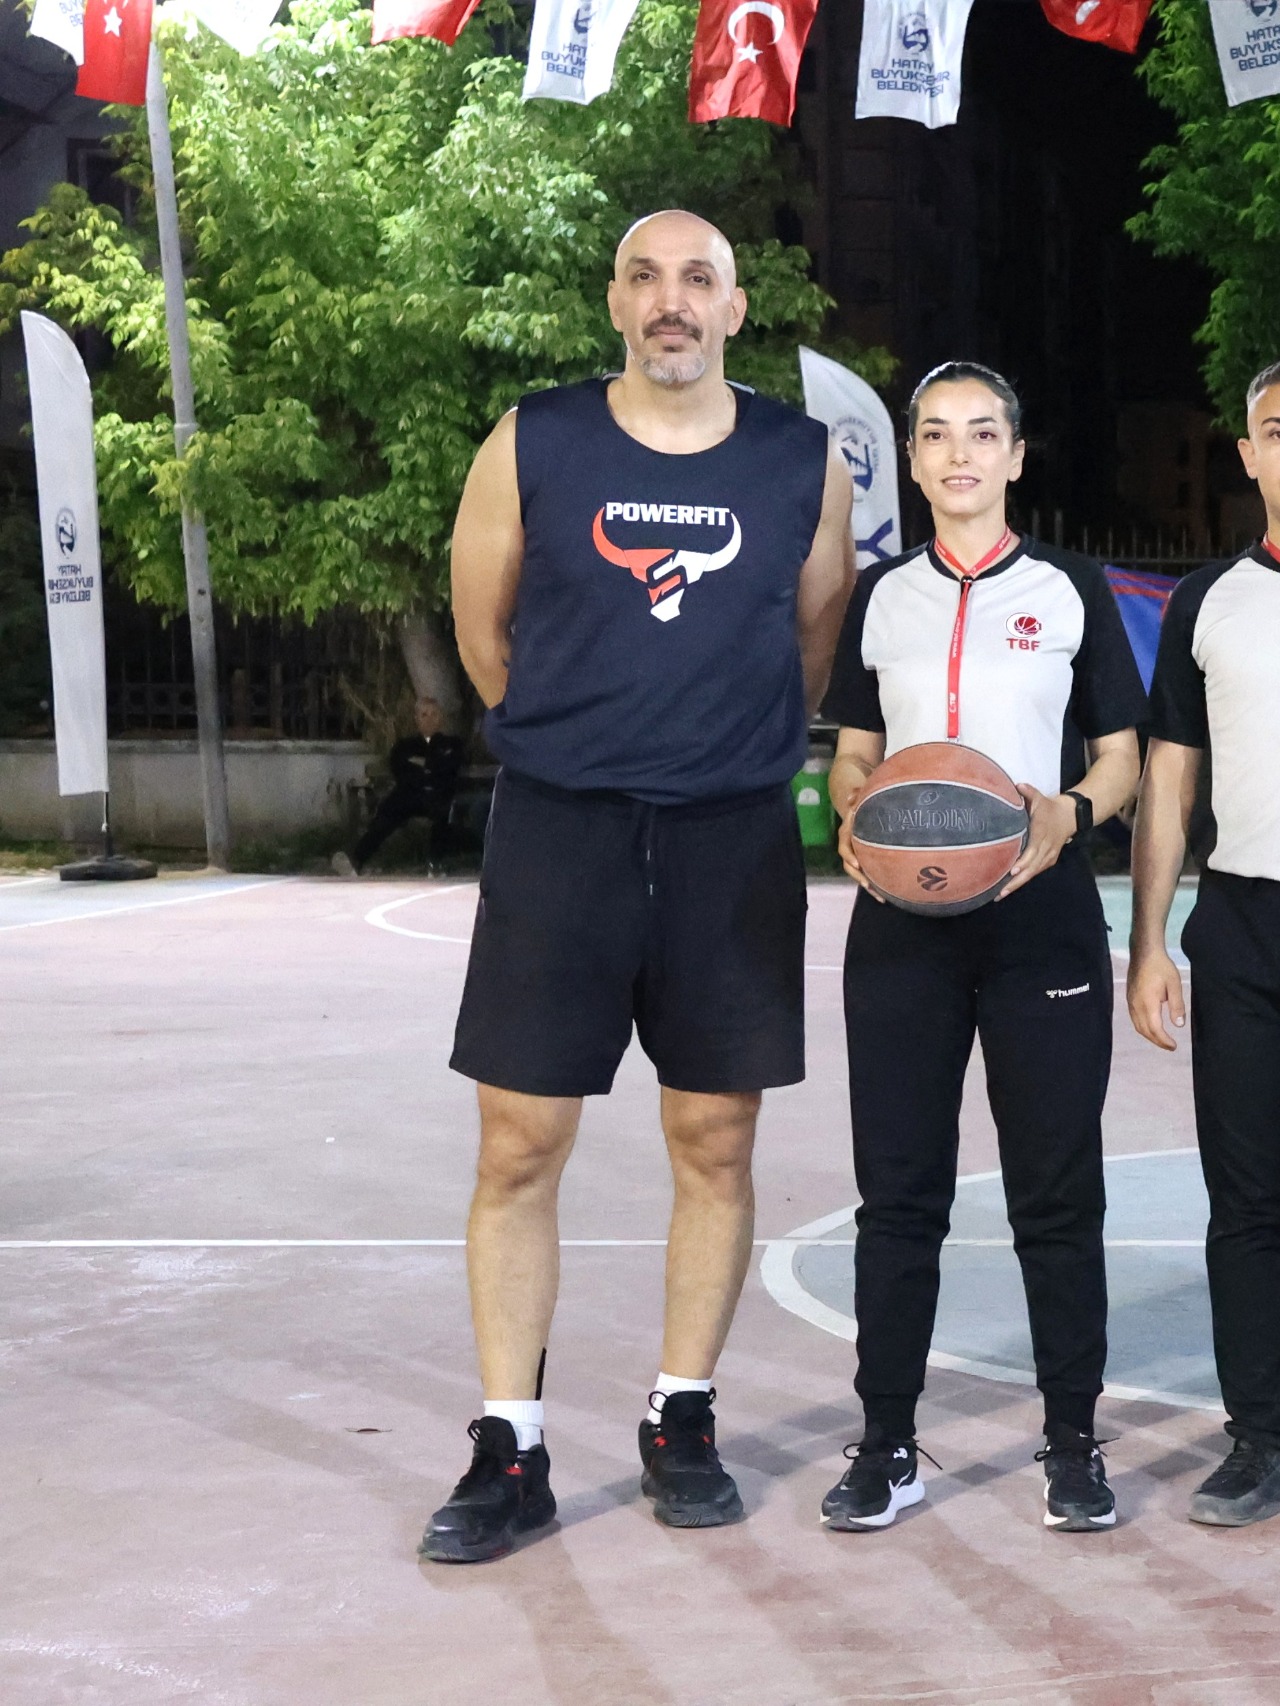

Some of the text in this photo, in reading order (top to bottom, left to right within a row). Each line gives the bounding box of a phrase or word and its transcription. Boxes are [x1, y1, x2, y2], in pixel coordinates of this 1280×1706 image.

[563, 42, 587, 58] HAT
[892, 58, 933, 73] HATAY
[605, 501, 731, 526] POWERFIT
[1005, 637, 1041, 652] TBF
[1058, 982, 1090, 998] hummel
